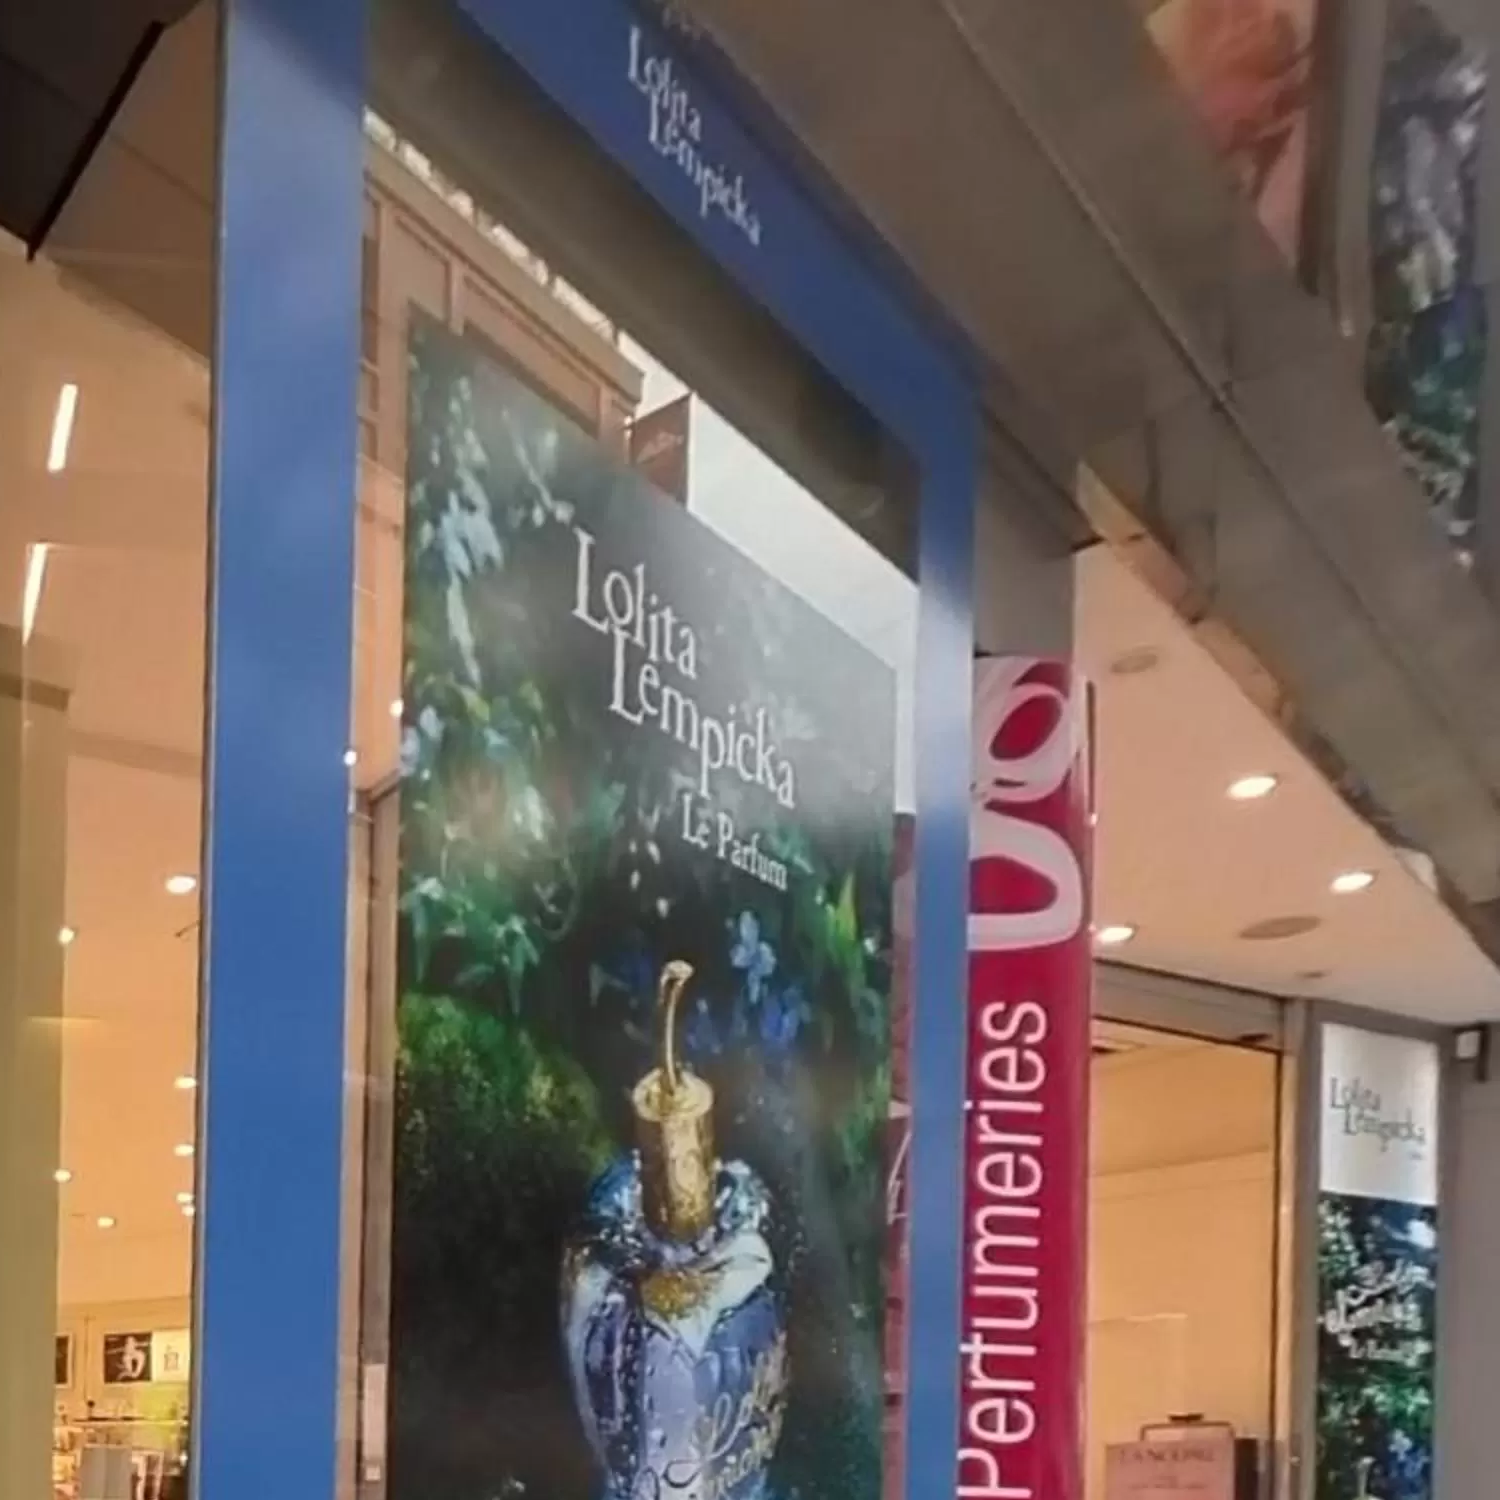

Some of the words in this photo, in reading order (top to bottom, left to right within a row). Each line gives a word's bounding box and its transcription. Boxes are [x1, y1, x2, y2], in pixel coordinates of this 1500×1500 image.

[628, 25, 702, 141] Lolita
[648, 92, 762, 248] Lempicka
[572, 527, 697, 680] Lolita
[608, 624, 795, 809] Lempicka
[681, 793, 710, 850] Le
[717, 812, 789, 891] Parfum
[956, 1000, 1049, 1500] Perfumeries
